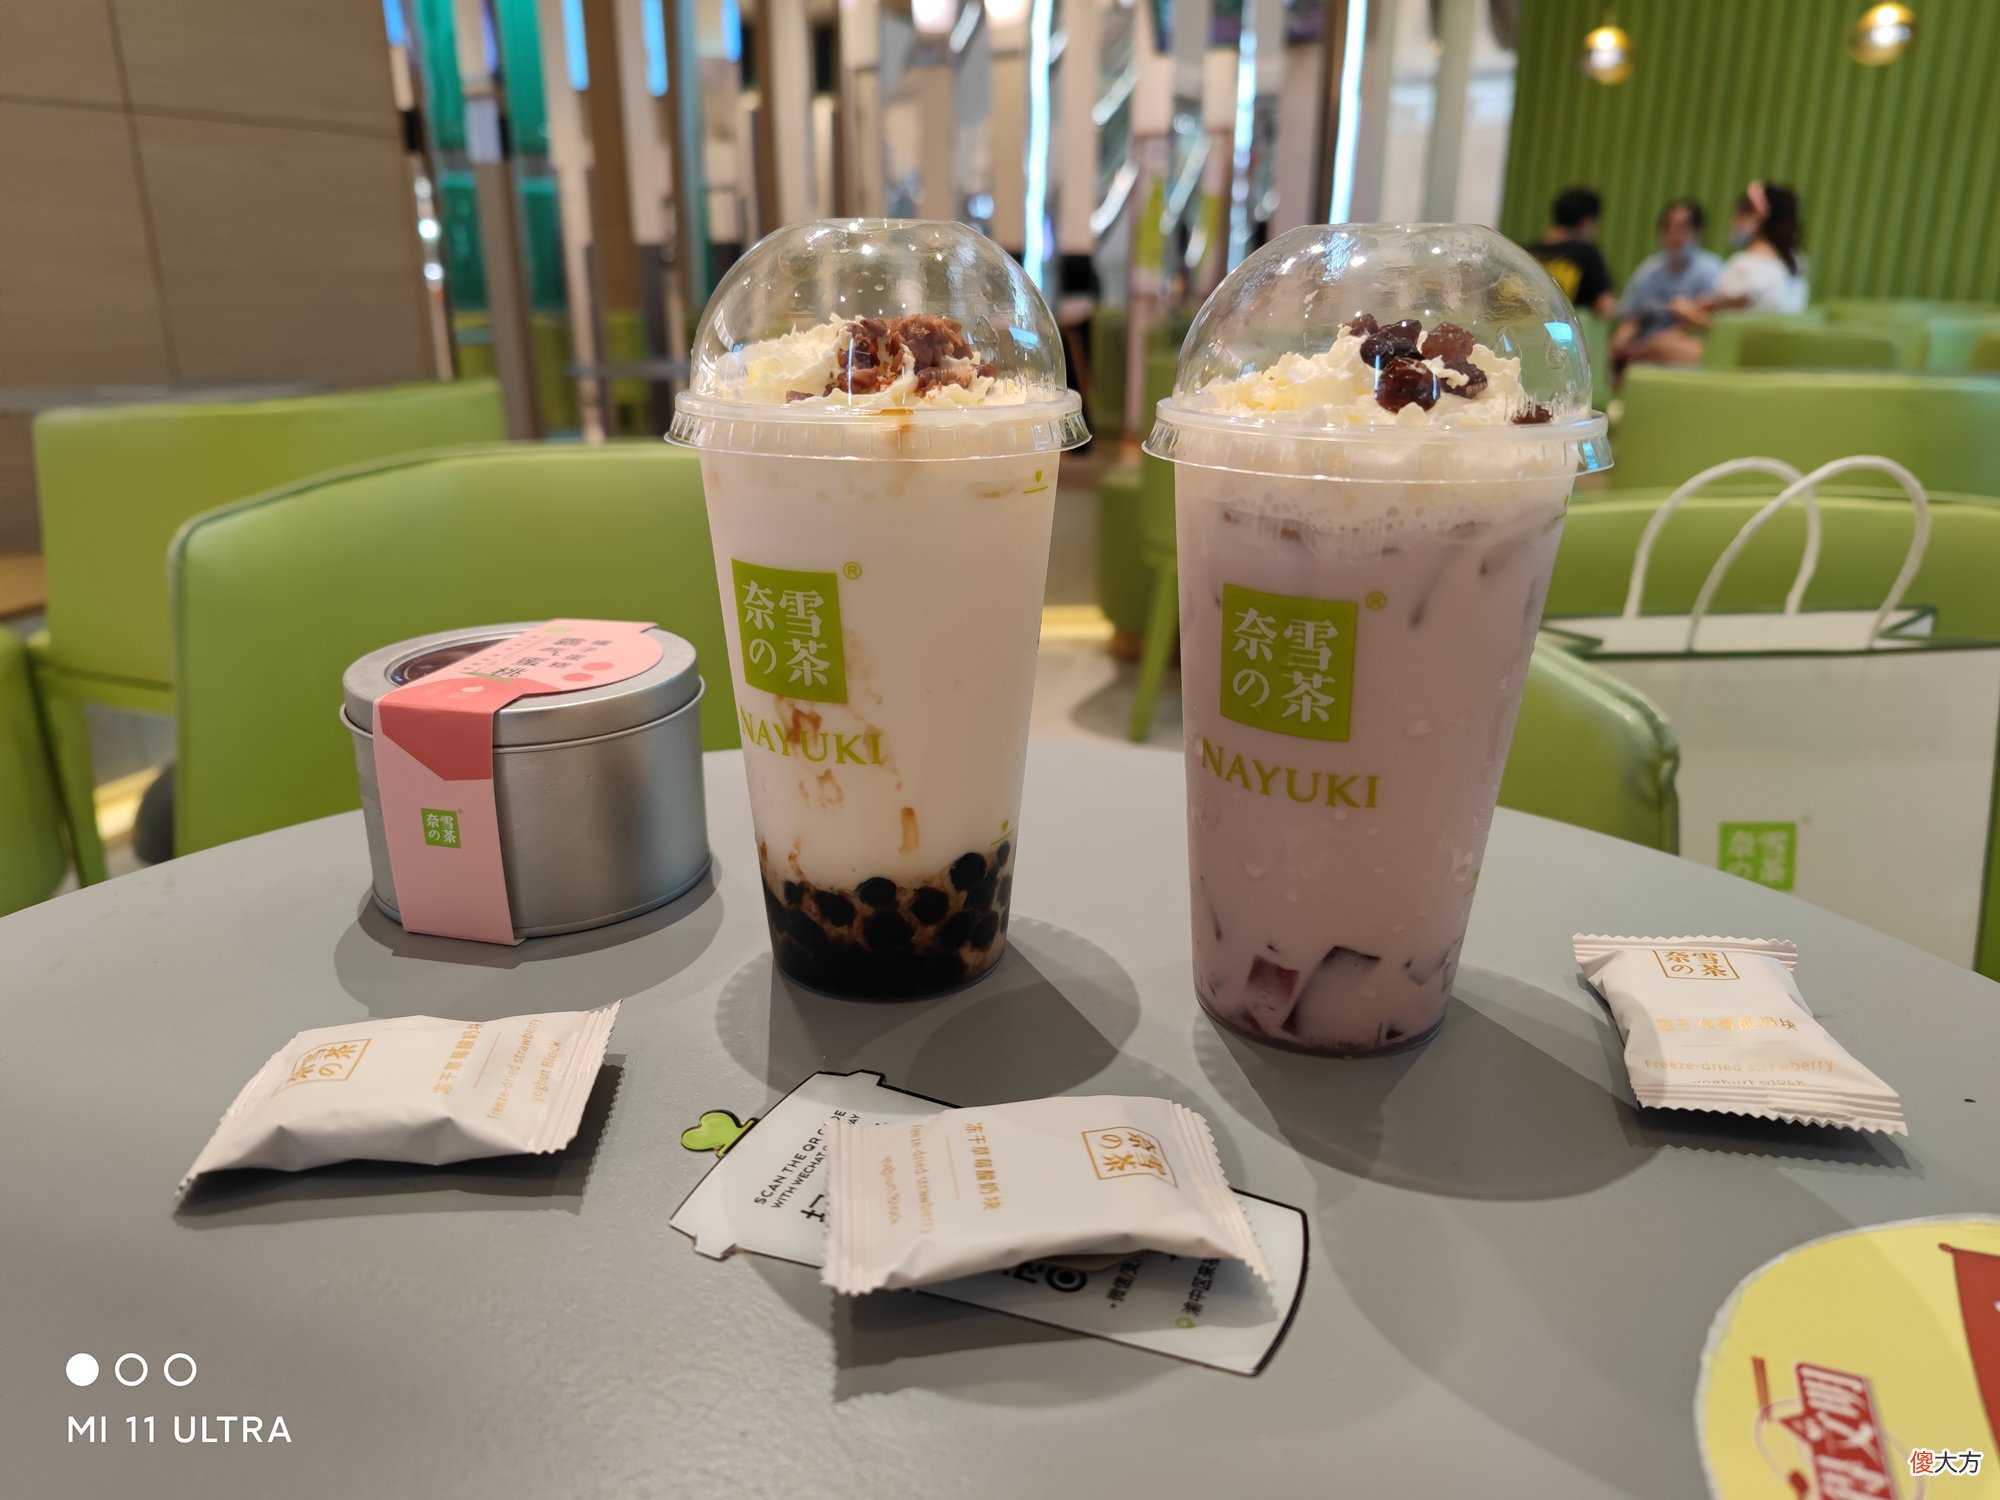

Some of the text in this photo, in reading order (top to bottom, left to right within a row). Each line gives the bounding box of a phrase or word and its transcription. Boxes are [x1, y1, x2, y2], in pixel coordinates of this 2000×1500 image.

[741, 580, 825, 638] 奈雪
[748, 637, 831, 687] の茶
[1232, 607, 1338, 671] 奈雪
[1232, 669, 1336, 723] の茶
[740, 705, 882, 765] NAYUKI
[1201, 737, 1380, 809] NAYUKI
[426, 813, 454, 831] 奈雪
[428, 829, 457, 844] の茶
[513, 1018, 543, 1064] strawberry
[541, 1041, 562, 1069] Block
[754, 1174, 787, 1205] SCAN
[781, 1153, 808, 1173] THE
[802, 1137, 822, 1152] QR
[770, 1186, 798, 1208] WITH
[791, 1151, 827, 1185] WECHAT
